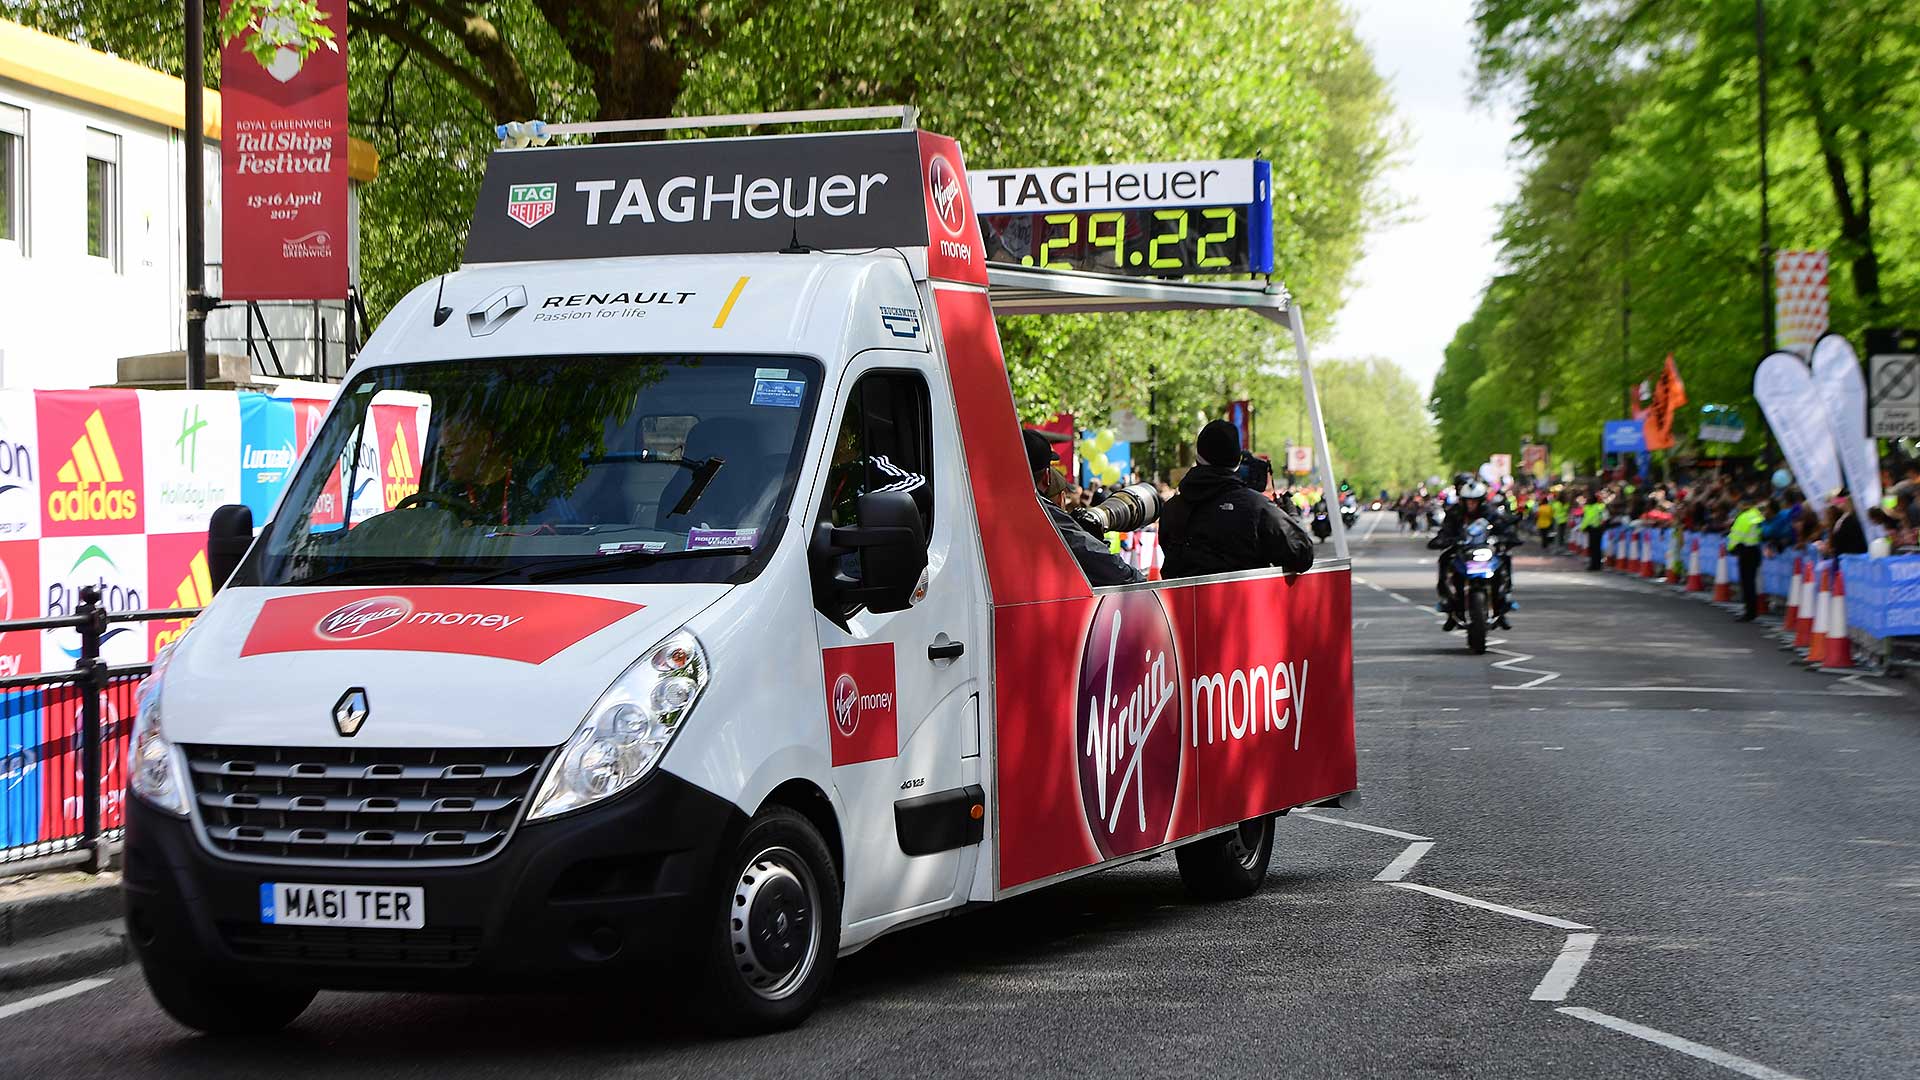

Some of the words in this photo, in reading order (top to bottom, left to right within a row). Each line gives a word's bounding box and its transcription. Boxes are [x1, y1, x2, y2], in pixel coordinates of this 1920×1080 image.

[236, 119, 267, 131] ROYAL
[270, 118, 332, 130] GREENWICH
[236, 132, 275, 152] Tall
[275, 131, 333, 155] Ships
[236, 151, 331, 175] Festival
[247, 193, 283, 208] 13-16
[284, 191, 322, 208] April
[513, 186, 553, 202] TAG
[934, 164, 960, 224] Virgin
[987, 169, 1220, 207] TAGHeuer
[270, 209, 299, 221] 2017
[510, 201, 554, 221] HEUER
[283, 249, 332, 258] GREENWICH
[940, 239, 972, 265] money
[542, 291, 697, 310] RENAULT
[533, 308, 593, 324] Passion
[597, 308, 621, 321] for
[625, 306, 647, 320] life
[48, 482, 137, 521] adidas
[47, 576, 144, 633] Buton
[327, 602, 403, 634] Virgin
[407, 610, 524, 632] money
[836, 682, 858, 726] Virgin
[861, 692, 893, 713] money
[1086, 609, 1175, 834] Virgin
[1191, 658, 1309, 751] money
[355, 891, 411, 921] TER
